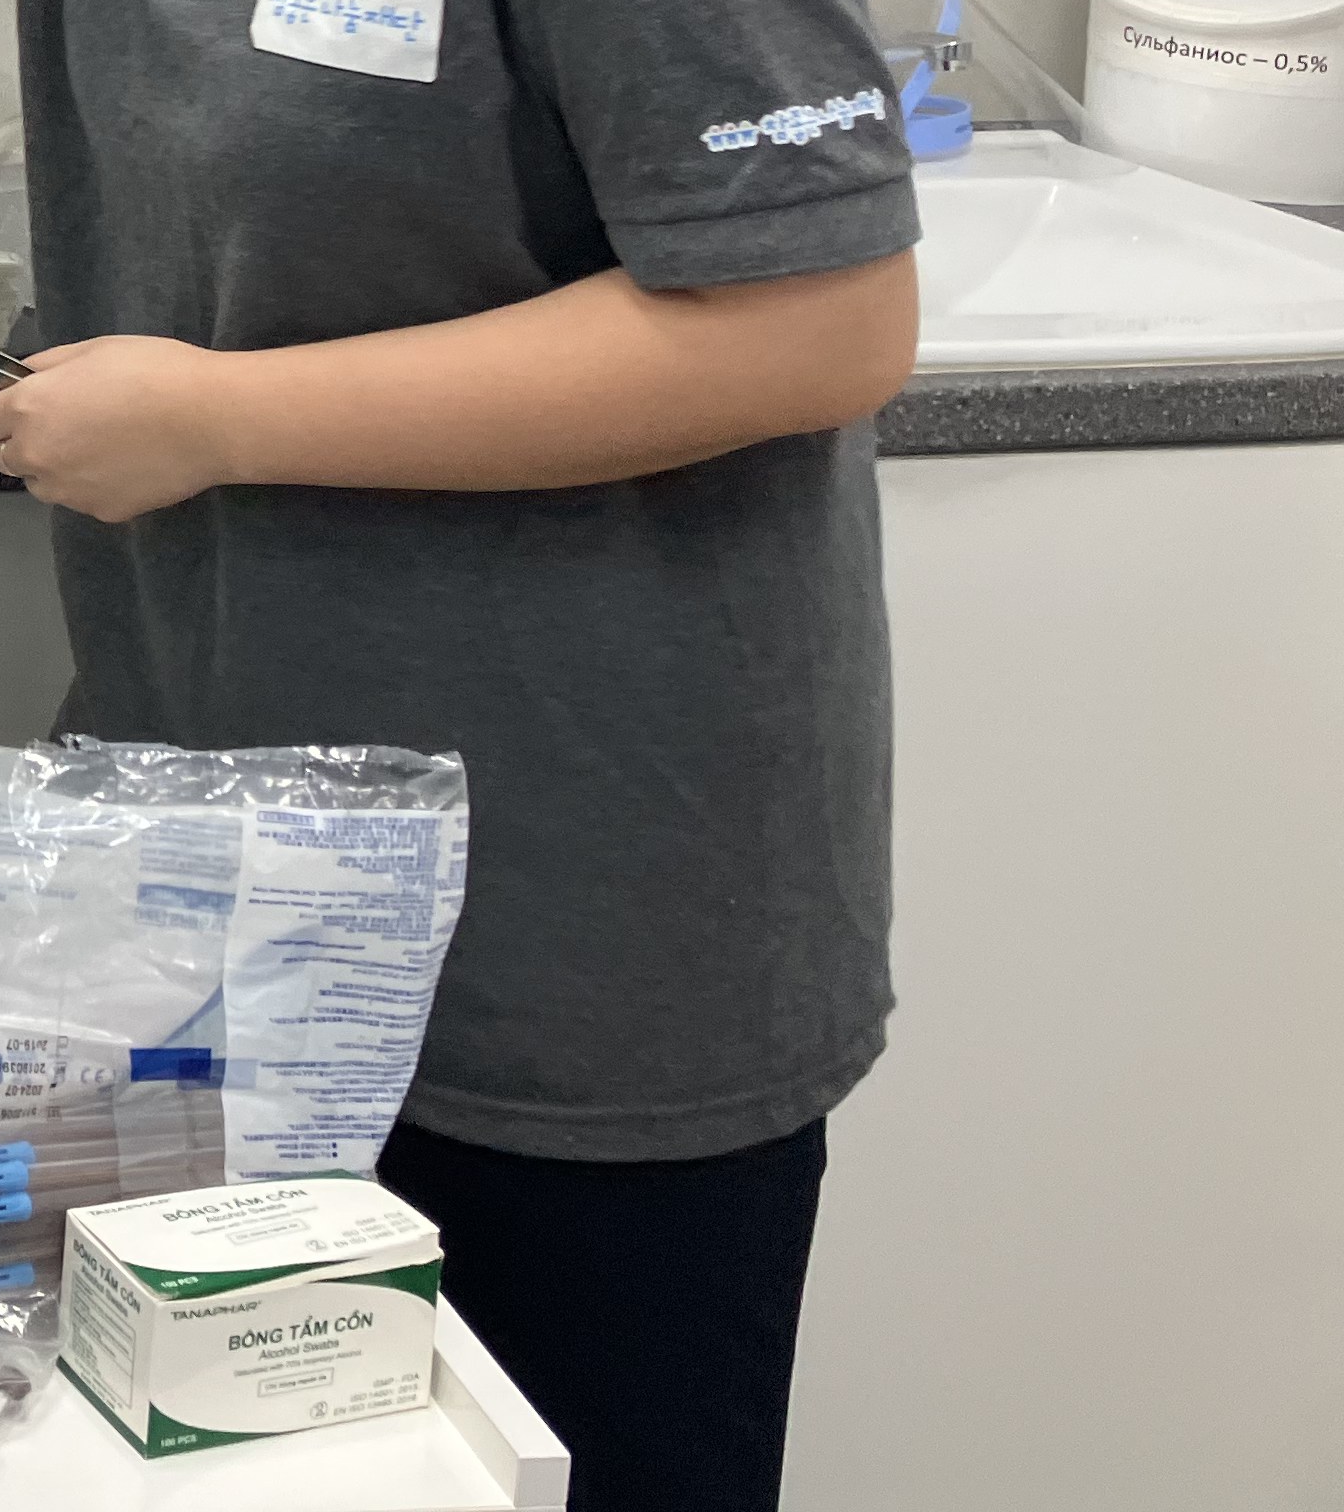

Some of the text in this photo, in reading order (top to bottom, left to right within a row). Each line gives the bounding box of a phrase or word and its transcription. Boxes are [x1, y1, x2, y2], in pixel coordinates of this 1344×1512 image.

[1123, 26, 1248, 66] Сульфаниос
[1274, 53, 1328, 74] 0,5%
[170, 1301, 259, 1321] TANAPHAR
[228, 1327, 283, 1351] BÔNG
[258, 1339, 340, 1361] Alcohol Swabs
